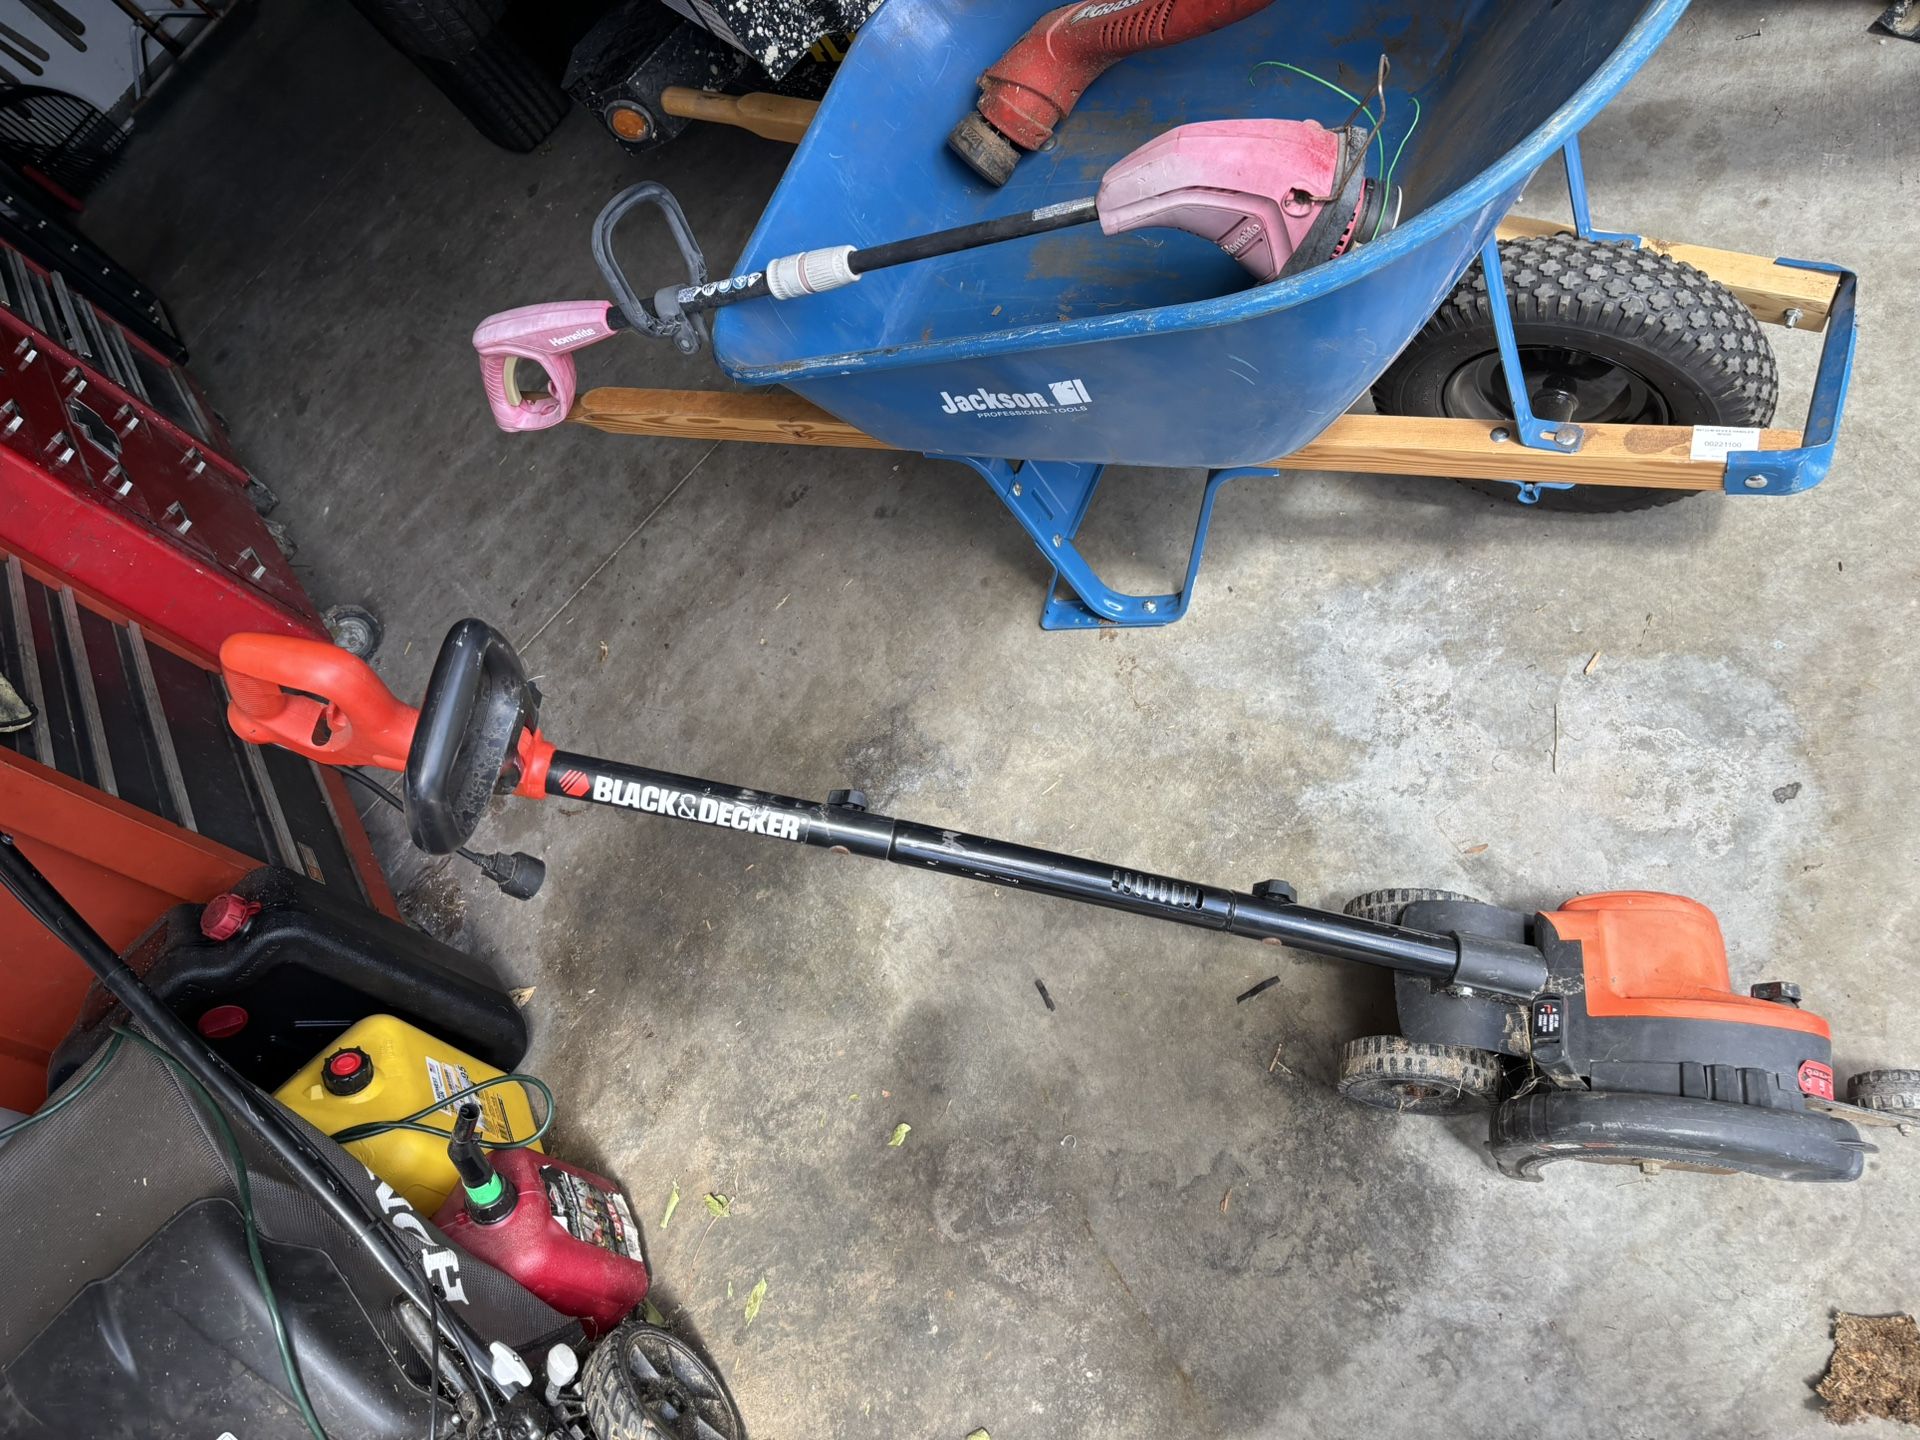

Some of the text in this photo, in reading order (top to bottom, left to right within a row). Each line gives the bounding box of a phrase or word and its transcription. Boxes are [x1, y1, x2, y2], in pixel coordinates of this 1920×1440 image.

[548, 328, 596, 347] Homelite
[940, 388, 1050, 414] Jackson
[977, 405, 1088, 419] PROFESSIONAL TOOLS
[1704, 440, 1742, 448] 00221100
